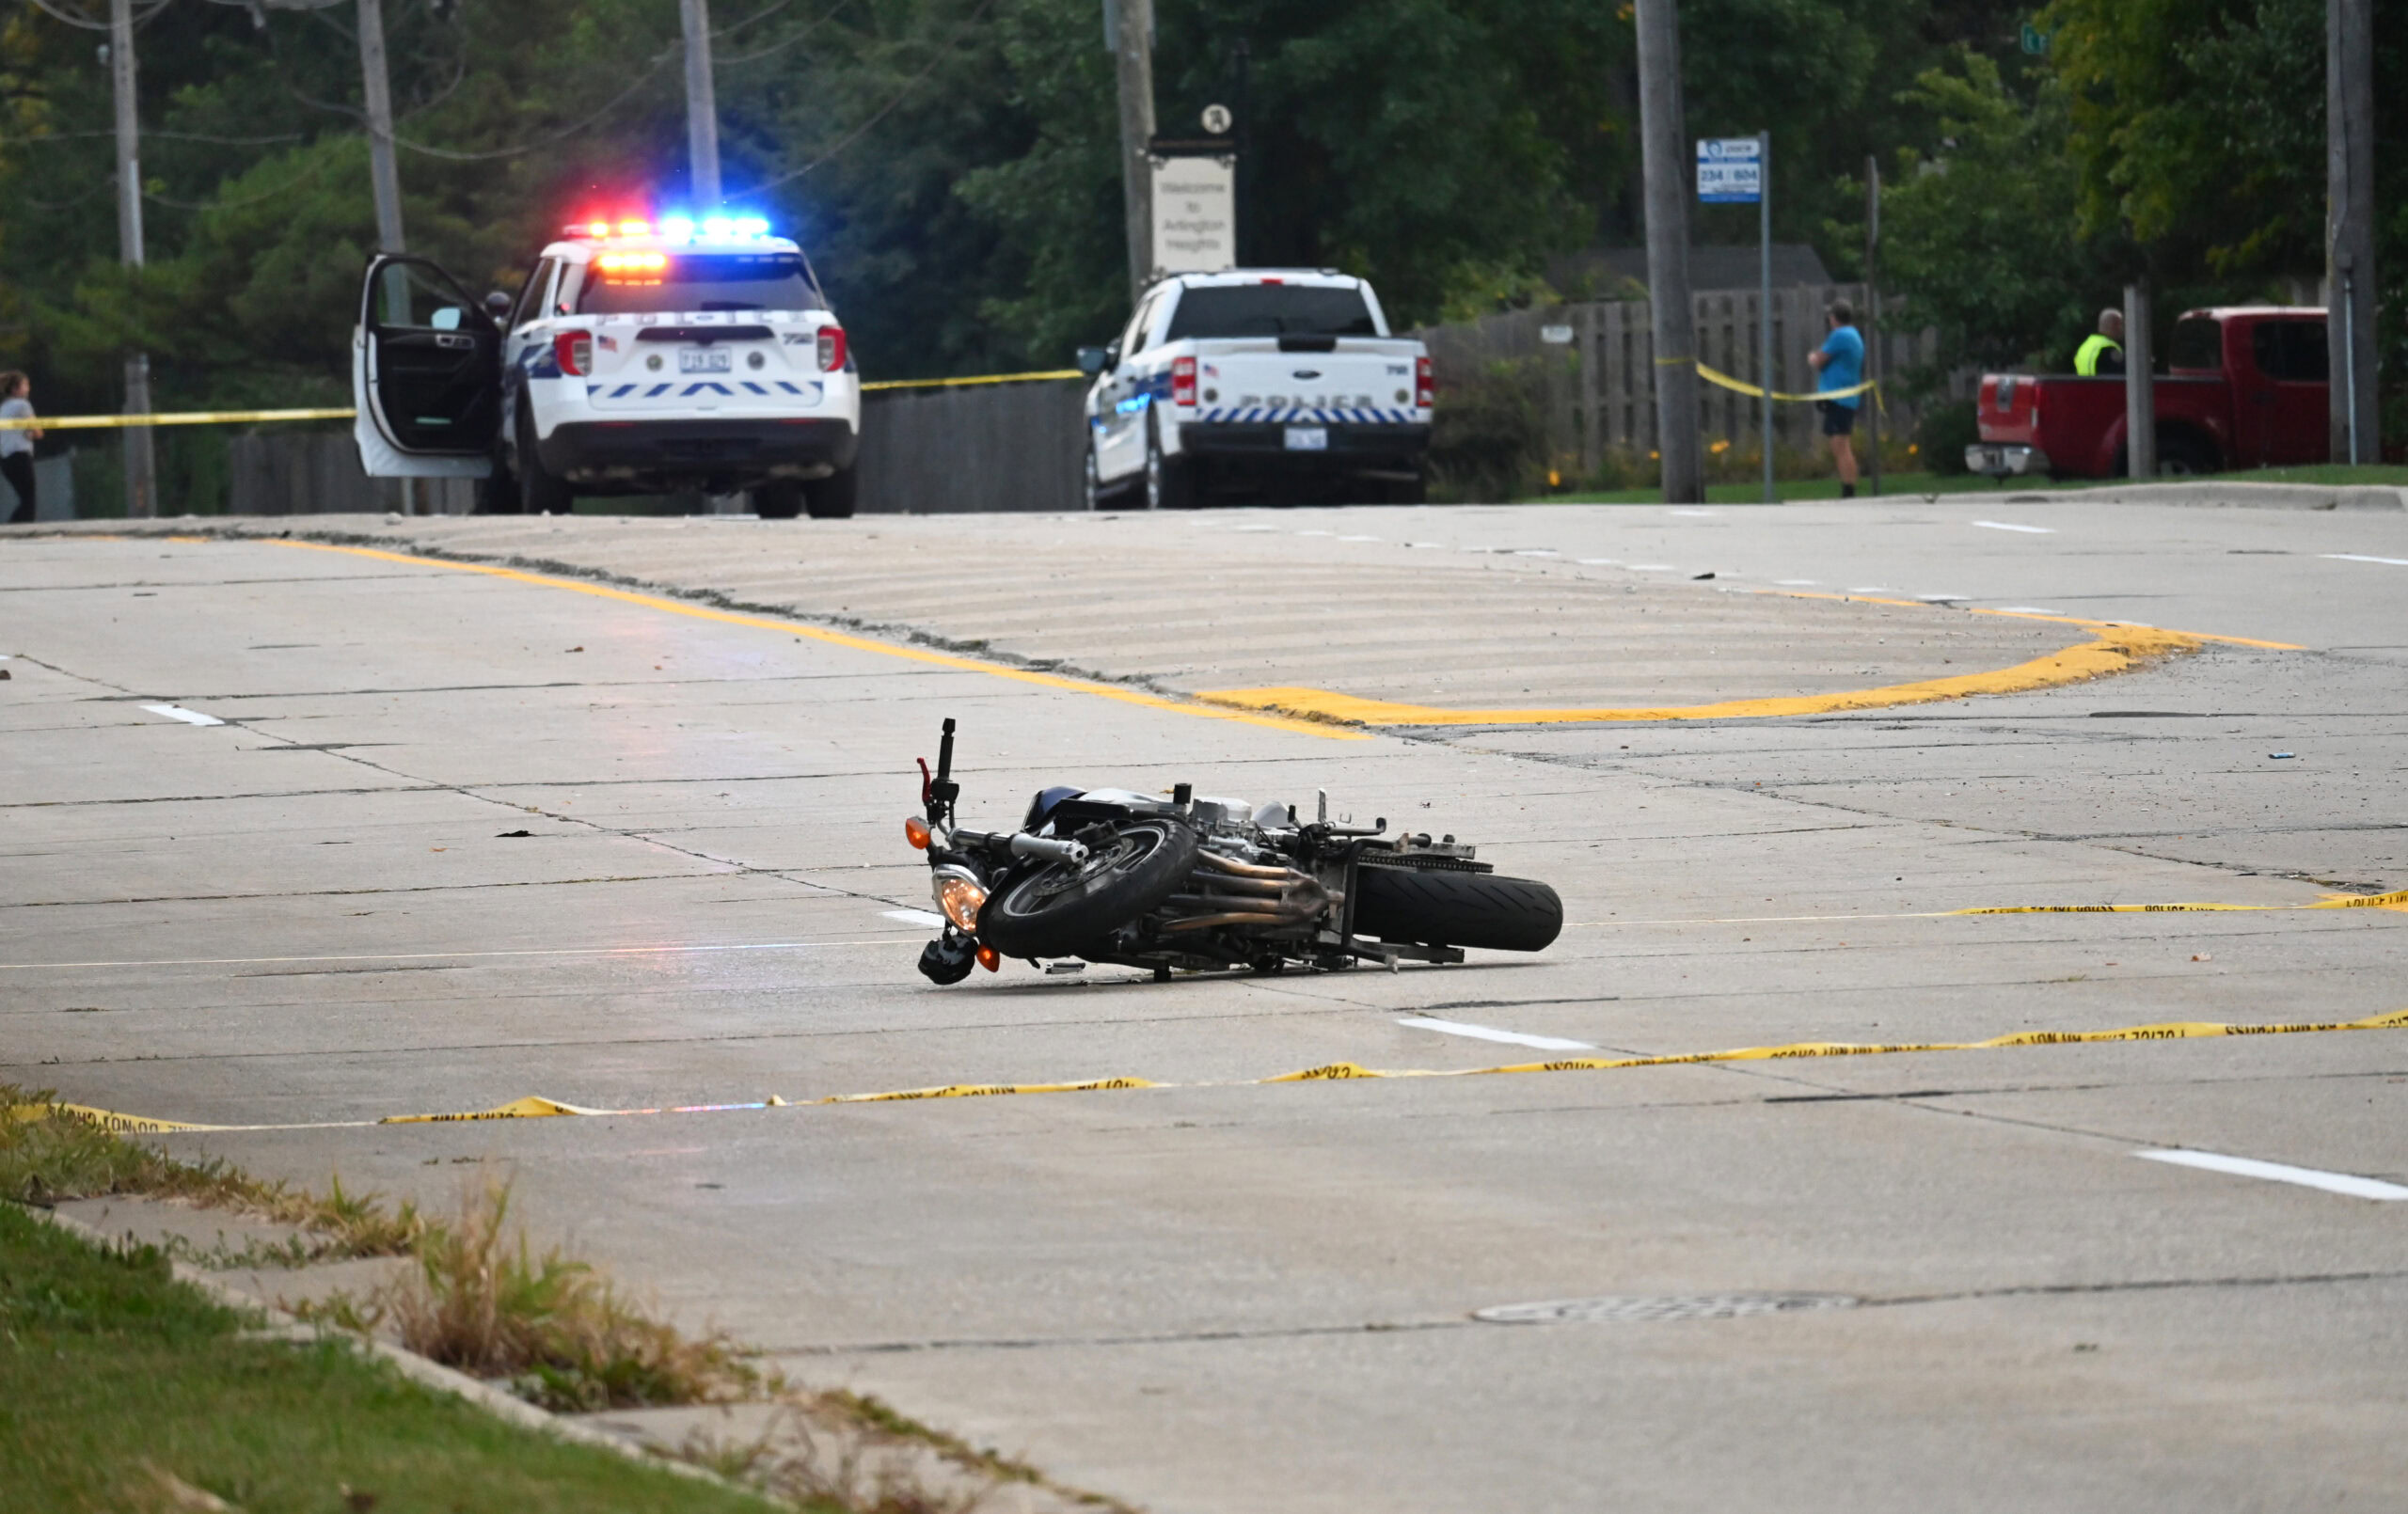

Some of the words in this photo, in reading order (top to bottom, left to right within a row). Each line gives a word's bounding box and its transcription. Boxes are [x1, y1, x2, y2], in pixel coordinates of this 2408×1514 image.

[1160, 182, 1226, 194] Welcome
[1163, 219, 1226, 235] Arlington
[1240, 394, 1373, 408] POLICE
